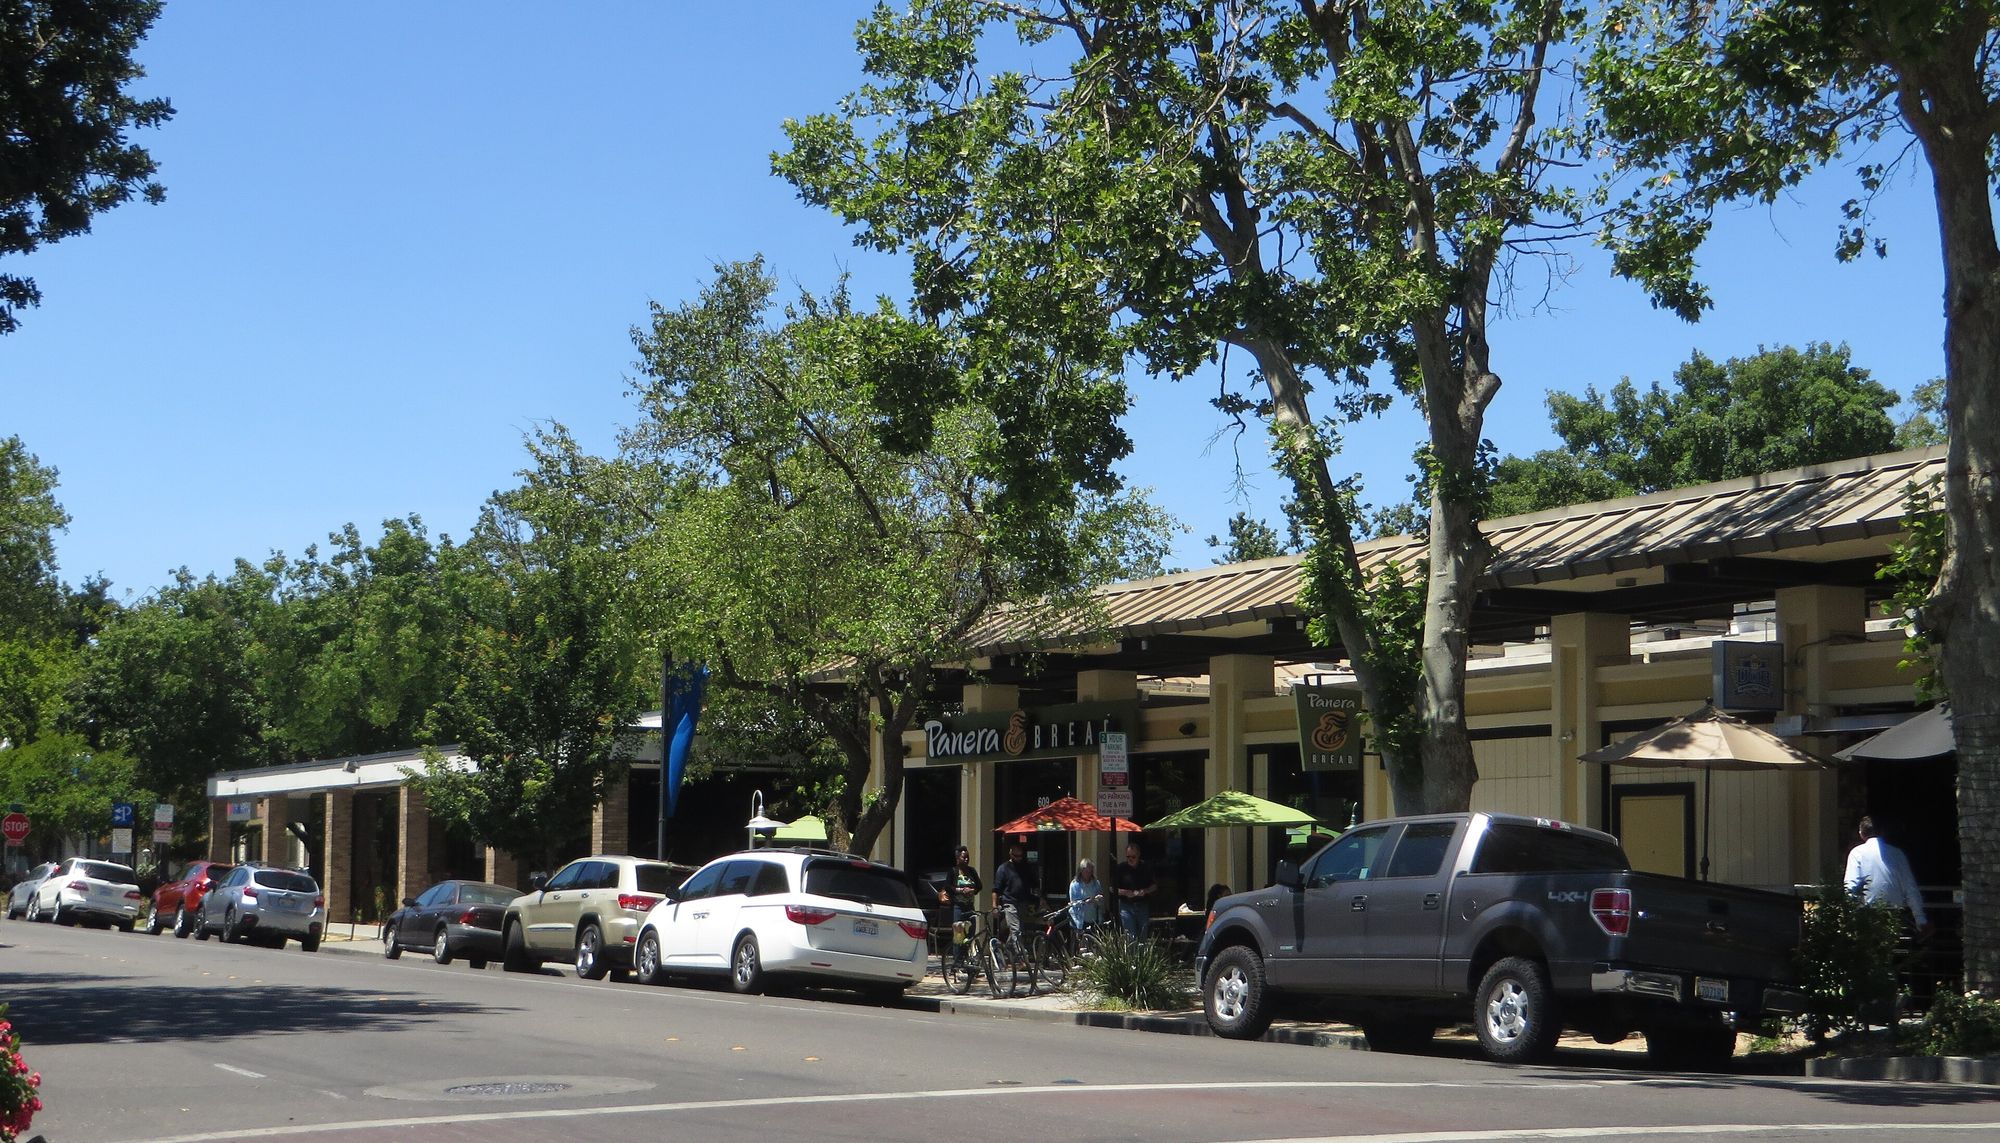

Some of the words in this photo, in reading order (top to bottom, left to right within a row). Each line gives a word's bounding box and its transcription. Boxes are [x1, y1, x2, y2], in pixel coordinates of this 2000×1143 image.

[1306, 693, 1355, 708] Panera
[924, 720, 1000, 758] Panera
[1101, 734, 1107, 743] 2
[1312, 754, 1353, 764] BREAD
[1037, 796, 1050, 808] 609
[4, 821, 29, 832] STOP
